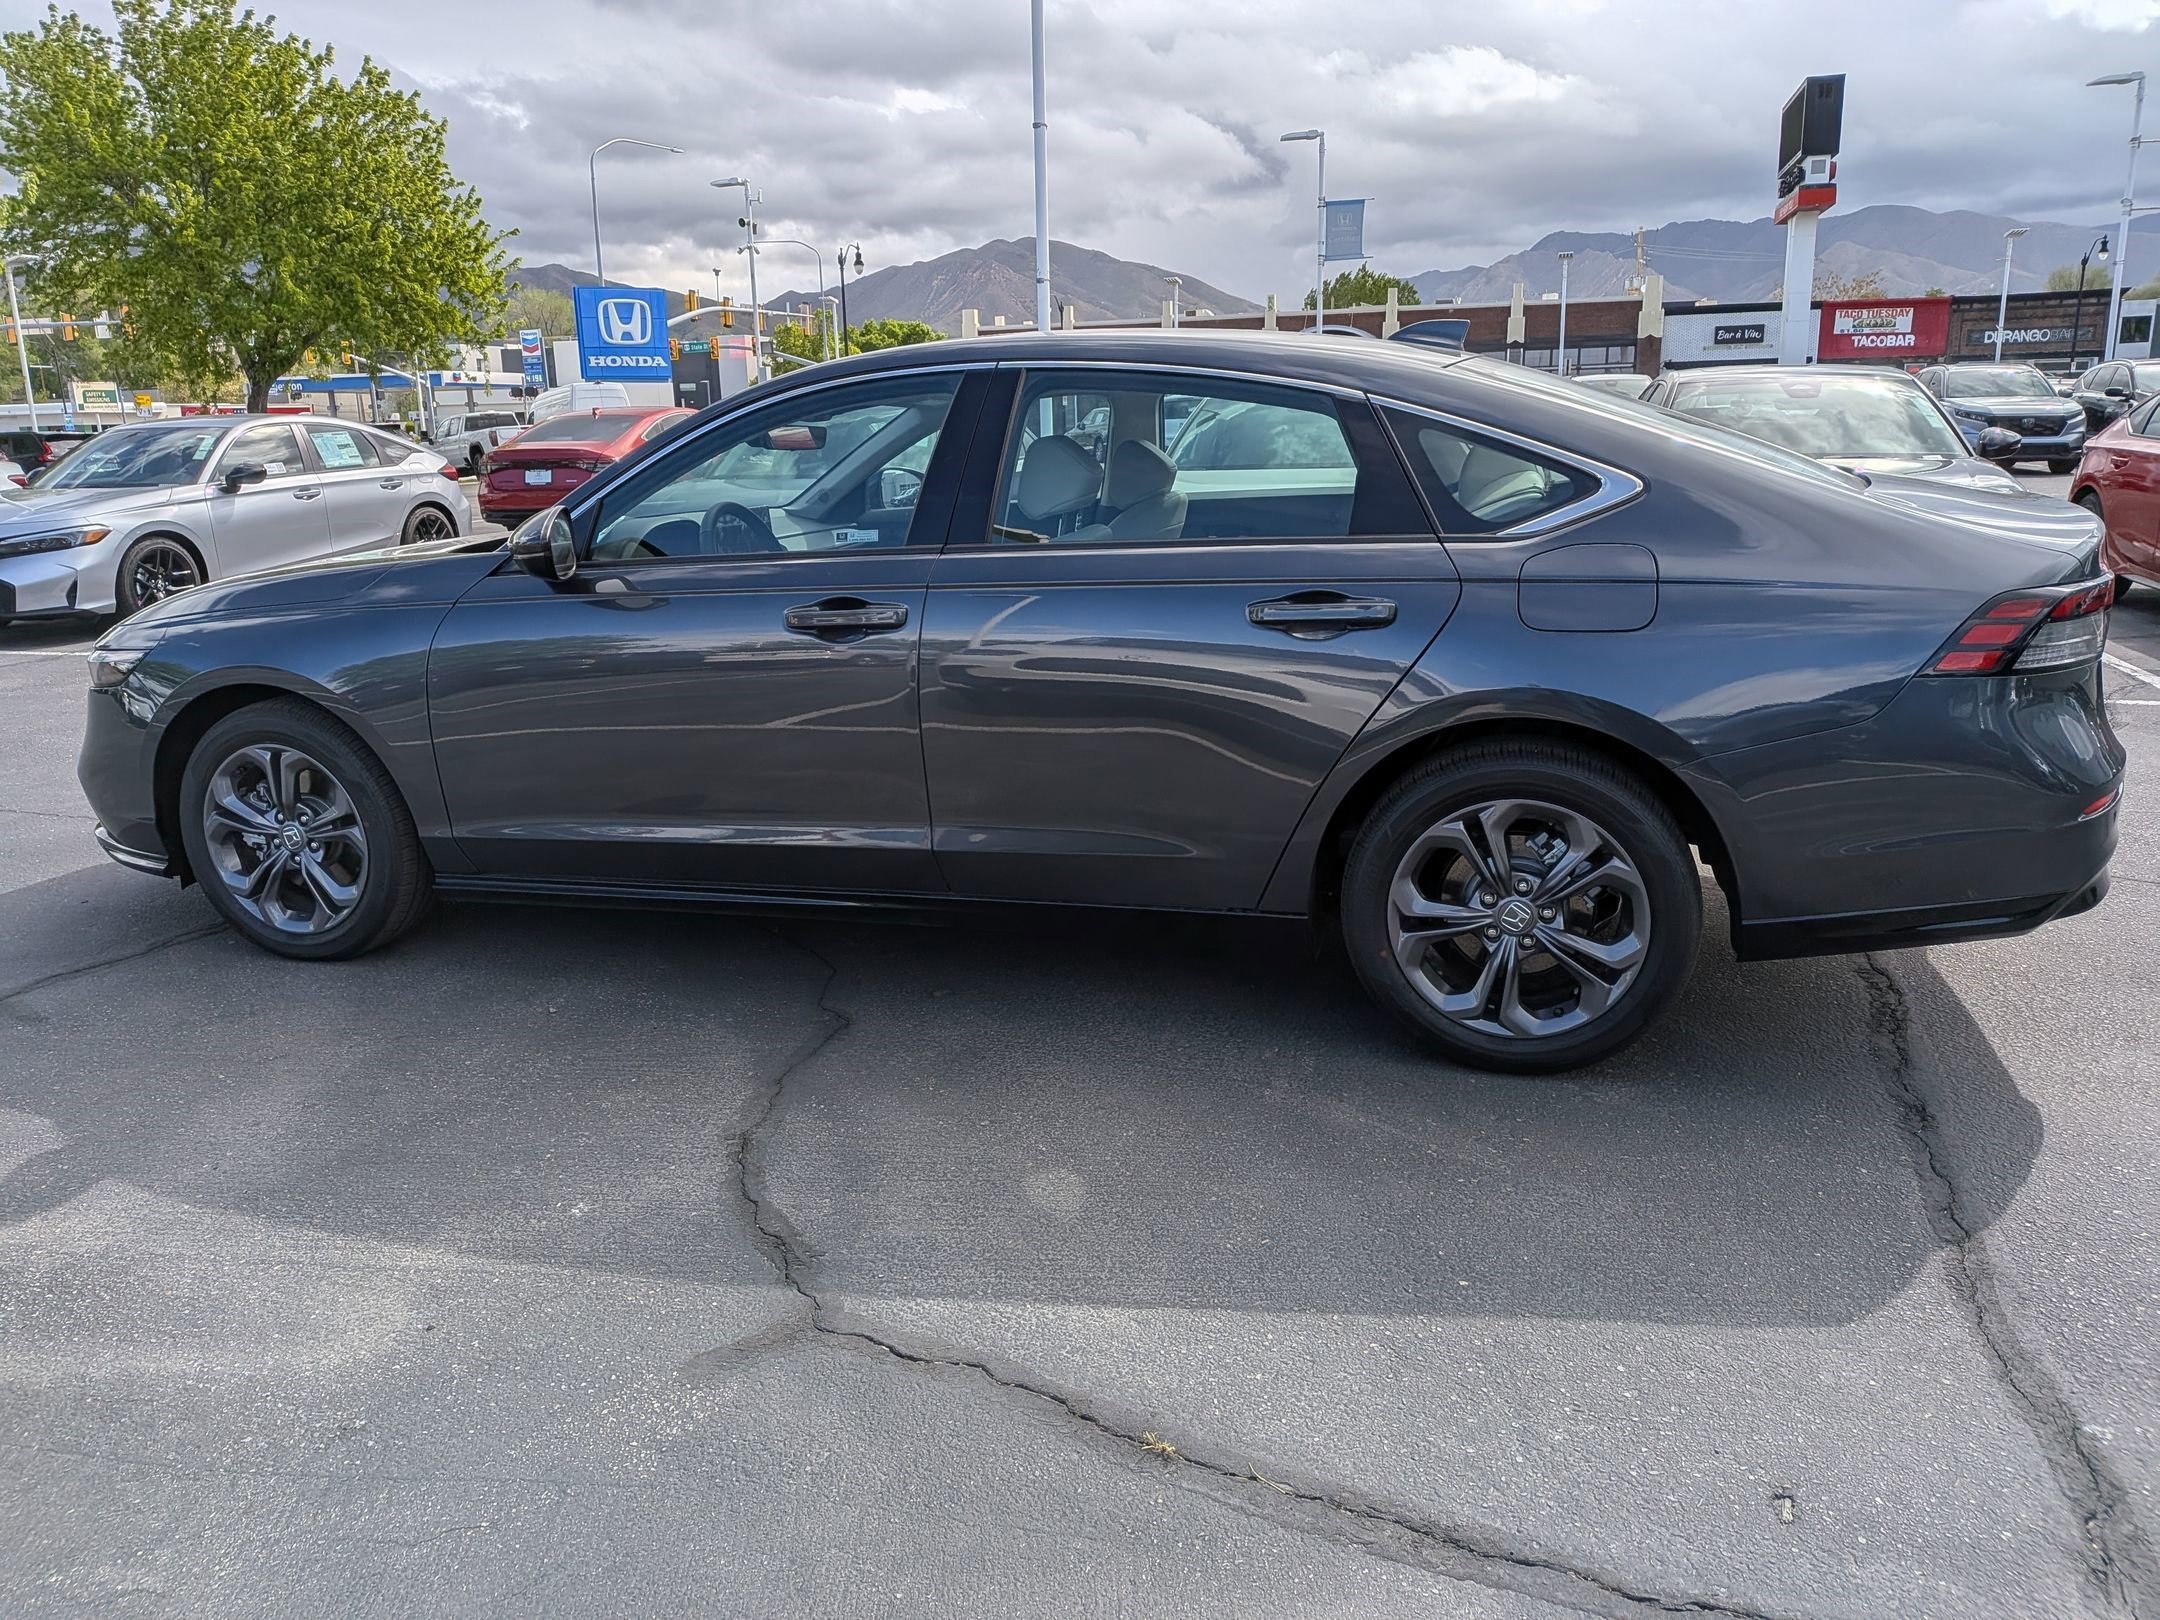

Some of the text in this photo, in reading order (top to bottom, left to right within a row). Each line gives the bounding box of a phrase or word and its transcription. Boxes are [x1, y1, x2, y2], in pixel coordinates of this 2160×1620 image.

[1838, 308, 1911, 319] TACO TUESDAY
[1717, 330, 1735, 340] Bar
[1744, 328, 1762, 339] Vin
[1851, 334, 1916, 347] TACOBAR
[588, 355, 668, 367] HONDA
